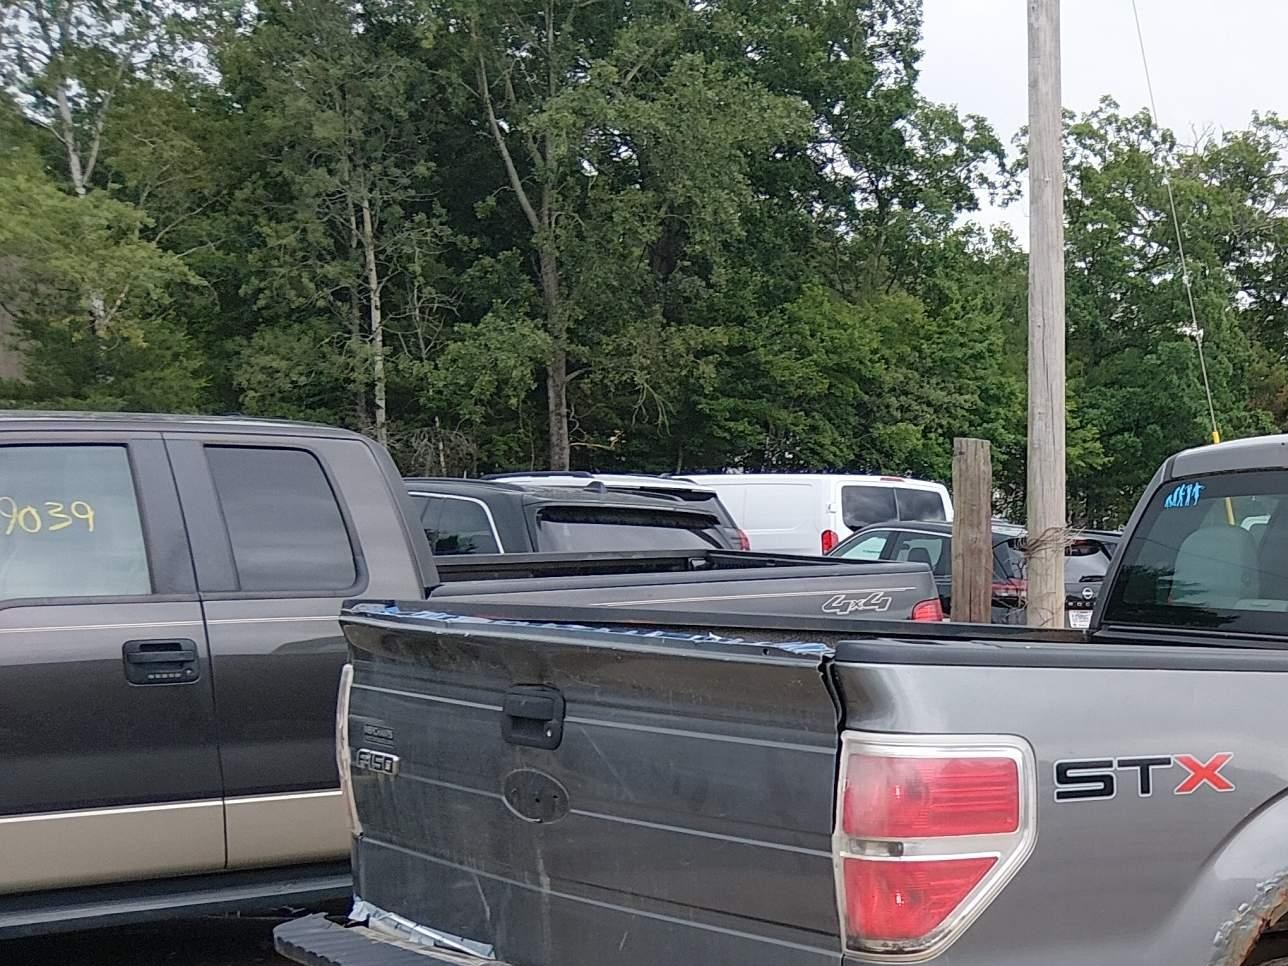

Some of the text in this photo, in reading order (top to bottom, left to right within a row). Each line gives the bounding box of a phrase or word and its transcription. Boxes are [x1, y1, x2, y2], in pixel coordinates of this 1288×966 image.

[0, 496, 96, 536] 9039
[822, 591, 892, 615] 4x4
[1054, 752, 1235, 803] STX
